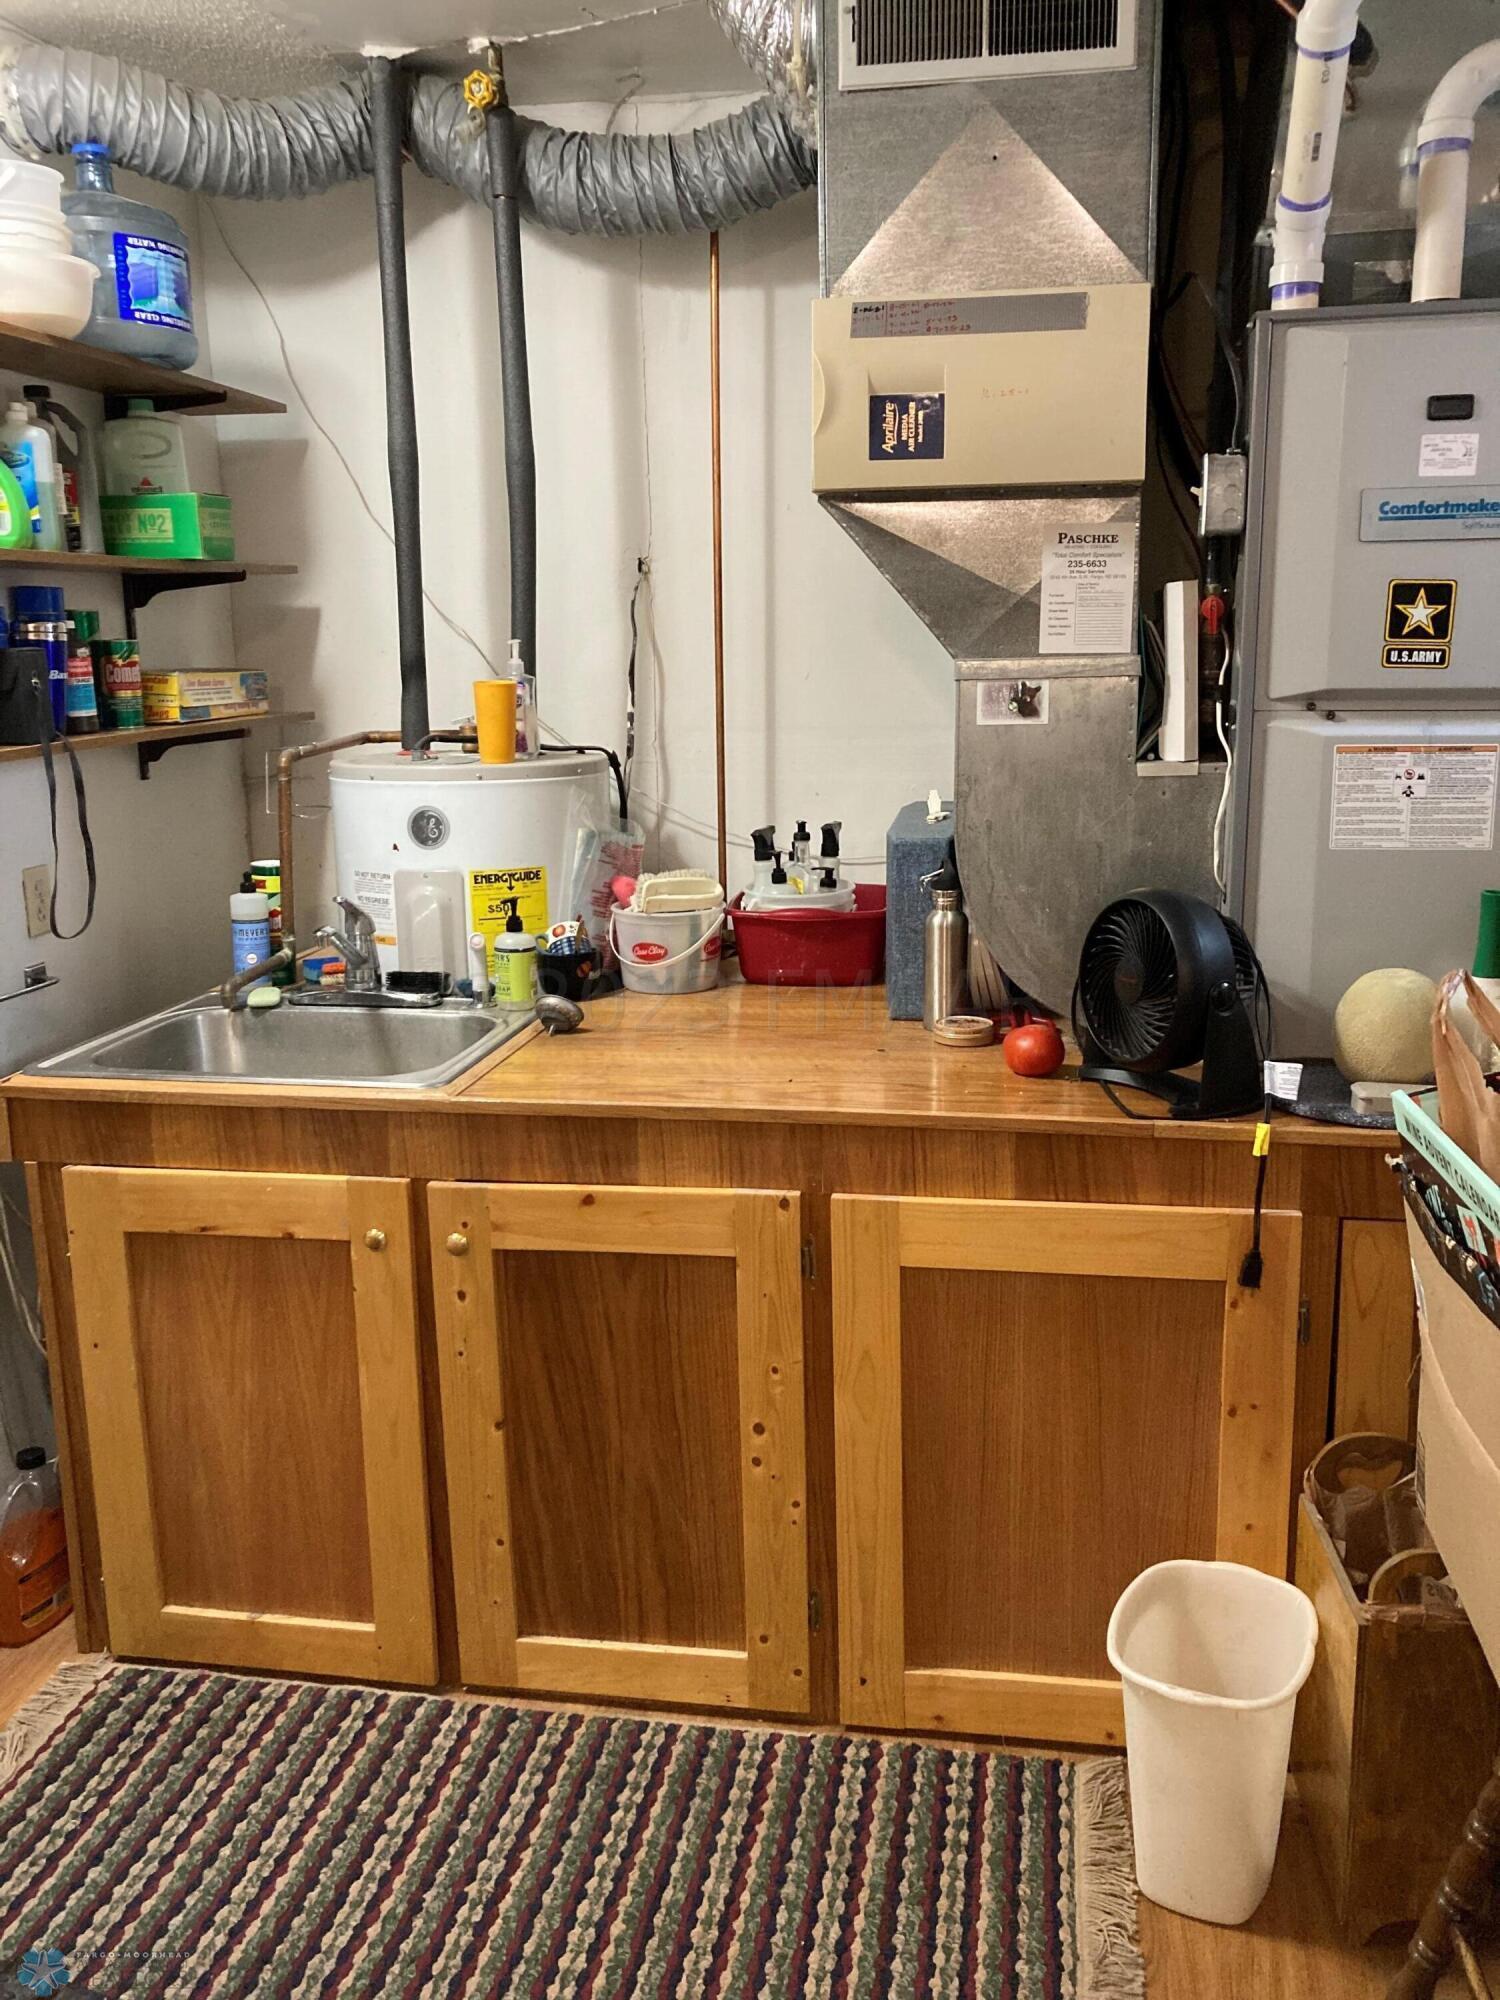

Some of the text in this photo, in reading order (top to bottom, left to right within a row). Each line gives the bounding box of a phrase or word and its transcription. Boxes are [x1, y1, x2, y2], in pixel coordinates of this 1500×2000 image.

[881, 401, 898, 454] Aprilaire
[900, 413, 908, 441] MEDIA
[907, 401, 916, 453] AIR CLEANER
[1057, 532, 1120, 545] PASCHKE
[1067, 559, 1107, 569] 235-6633
[648, 945, 666, 956] Clay
[1423, 1133, 1455, 1180] ADVENT
